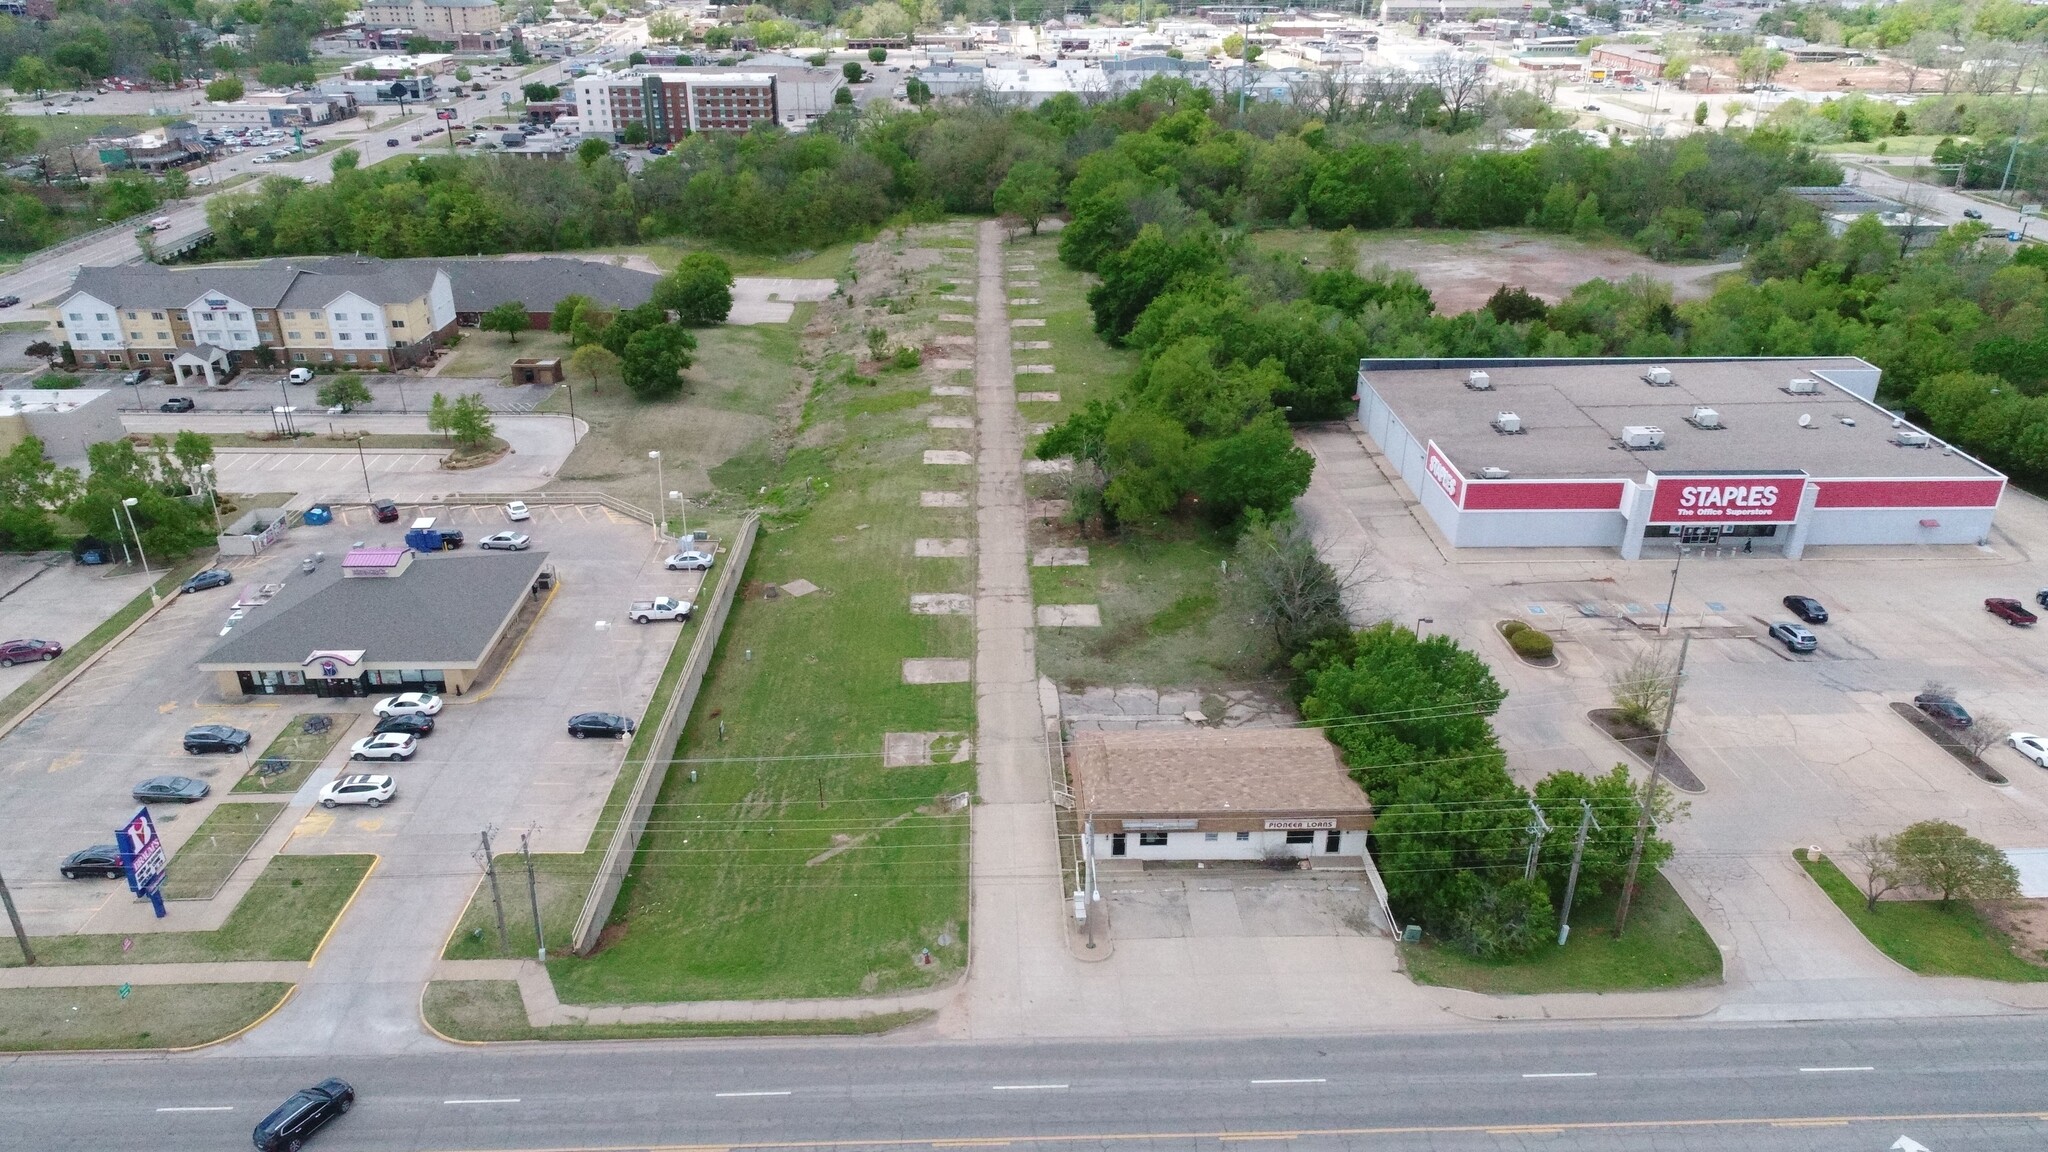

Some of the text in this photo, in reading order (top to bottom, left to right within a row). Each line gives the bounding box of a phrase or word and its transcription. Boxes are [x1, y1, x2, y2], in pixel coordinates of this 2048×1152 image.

[1680, 486, 1779, 506] STAPLES
[1678, 508, 1773, 516] The Office Superstore
